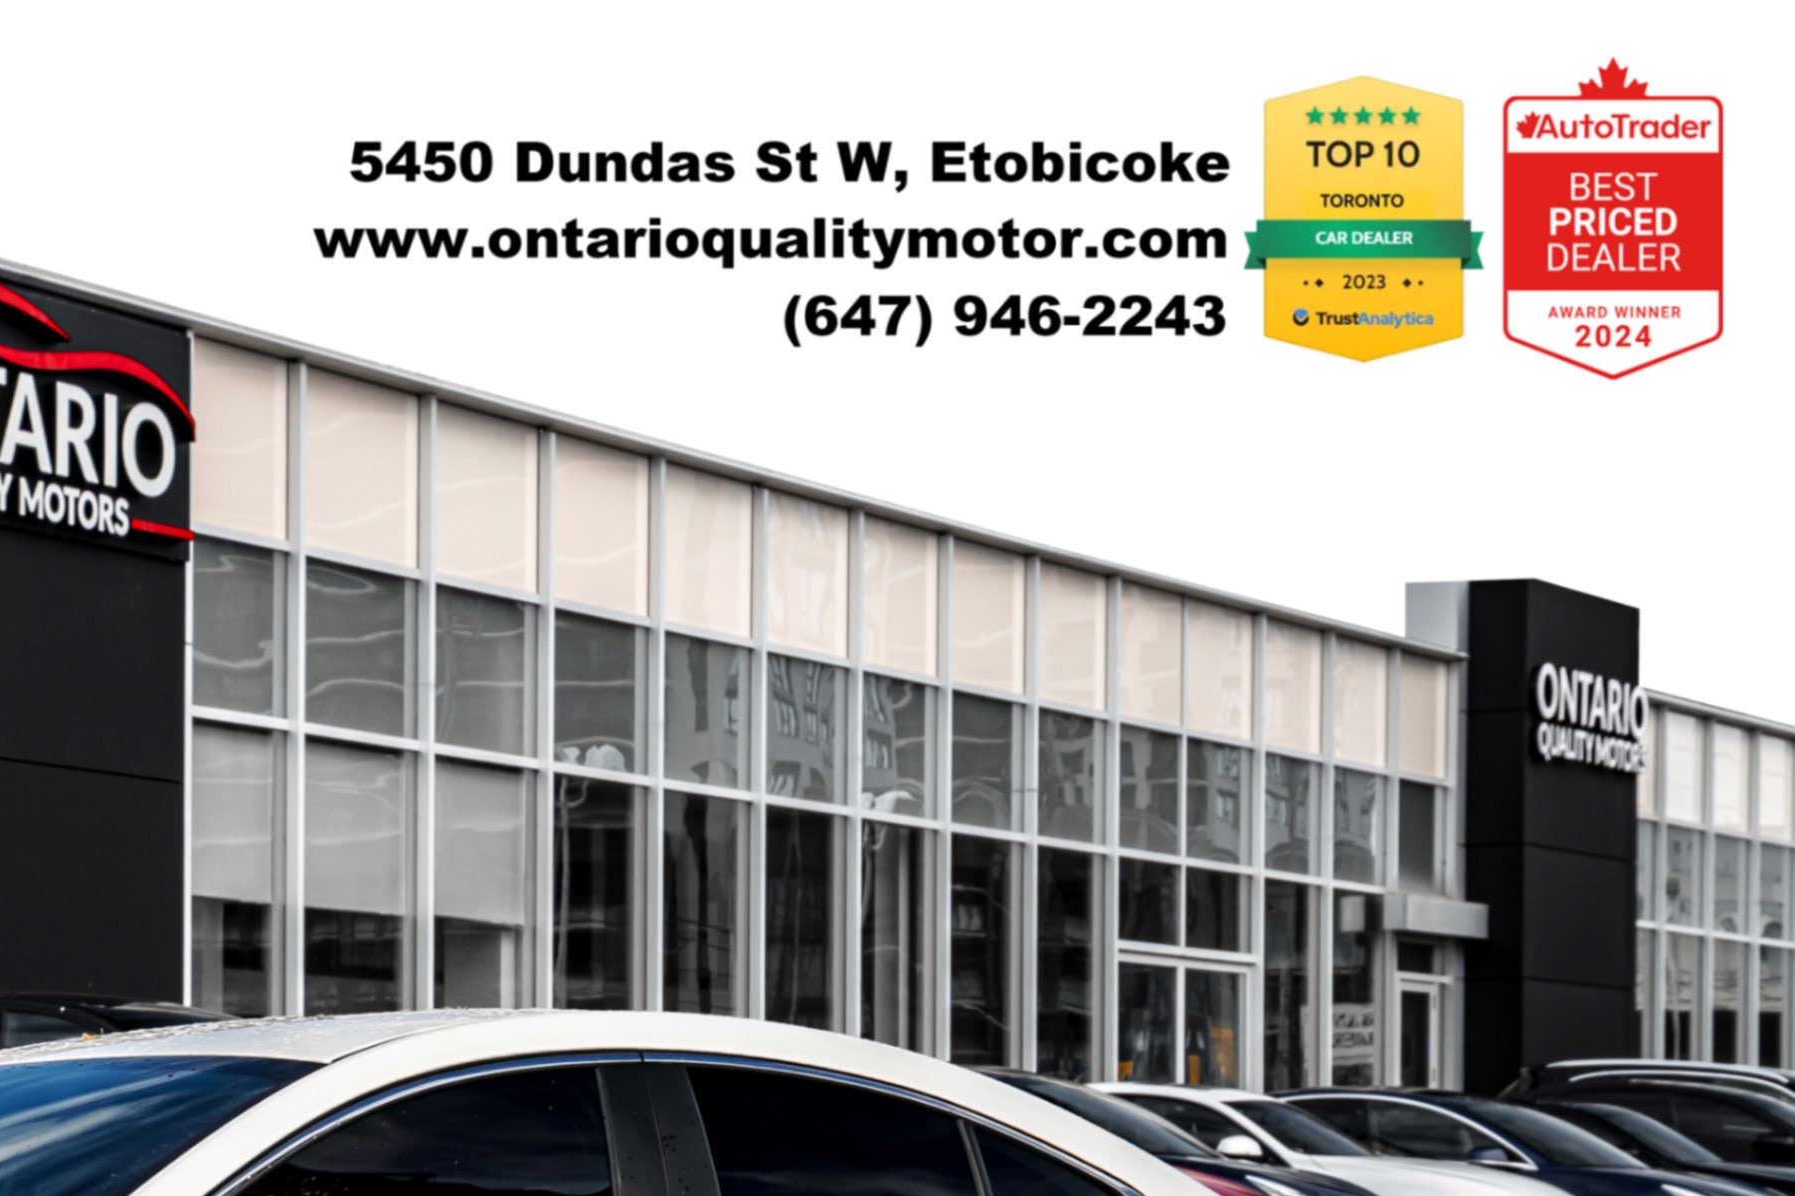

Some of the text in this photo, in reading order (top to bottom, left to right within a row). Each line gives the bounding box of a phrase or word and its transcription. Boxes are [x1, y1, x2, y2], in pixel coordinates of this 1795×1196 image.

[19, 476, 131, 537] MOTORS
[1536, 662, 1649, 740] ONTARIO
[1537, 722, 1646, 773] QUALITY MOTORS
